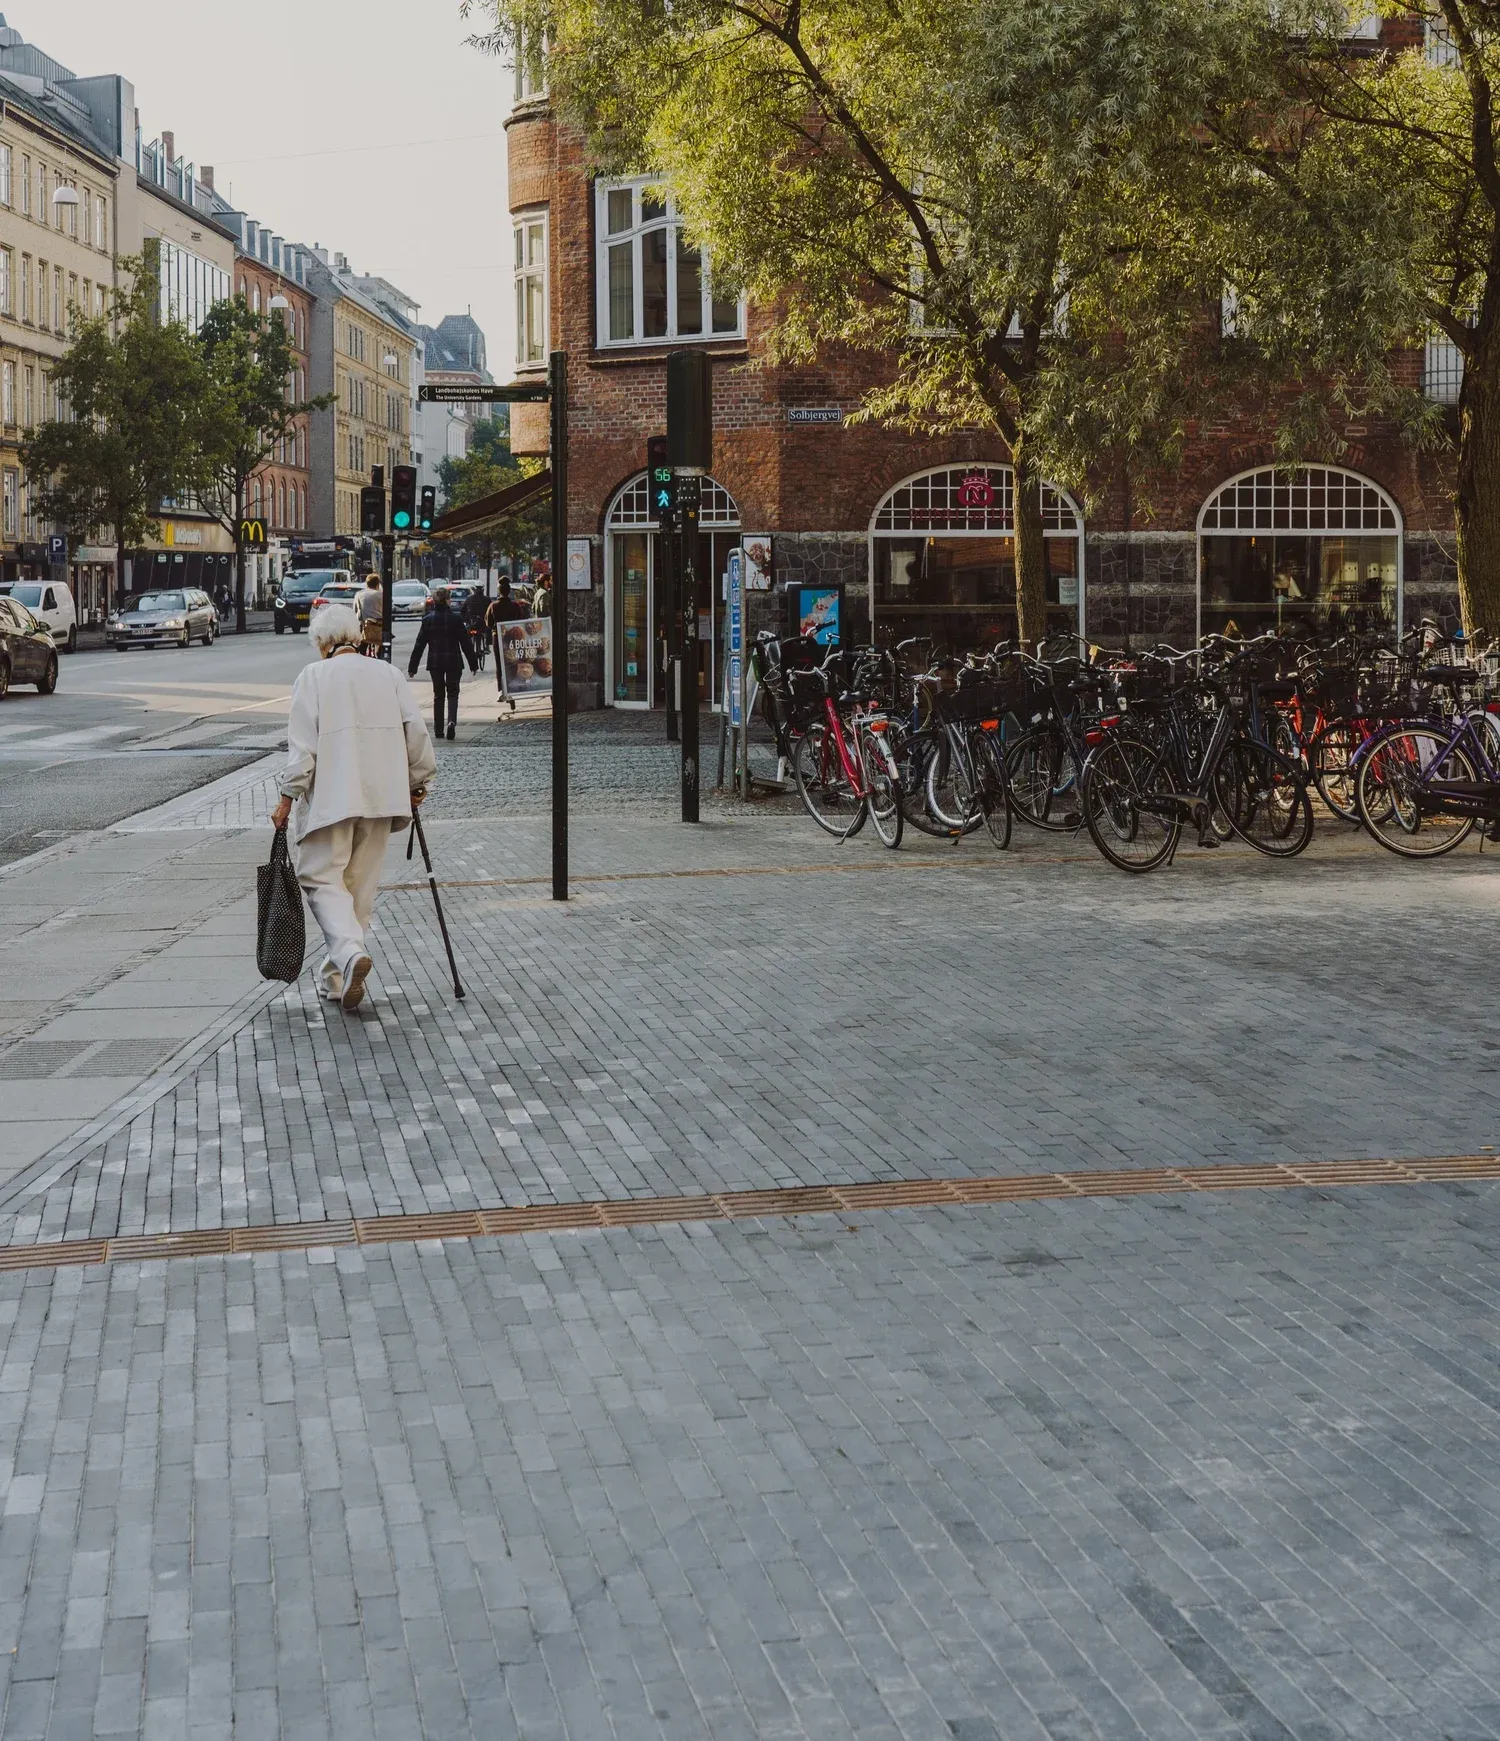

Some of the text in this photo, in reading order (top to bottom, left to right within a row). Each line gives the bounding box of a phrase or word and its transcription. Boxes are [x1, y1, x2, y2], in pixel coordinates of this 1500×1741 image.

[790, 410, 840, 421] Solbjergvej
[52, 538, 62, 552] P
[508, 638, 543, 650] 6 BOLLER
[515, 649, 525, 659] 49
